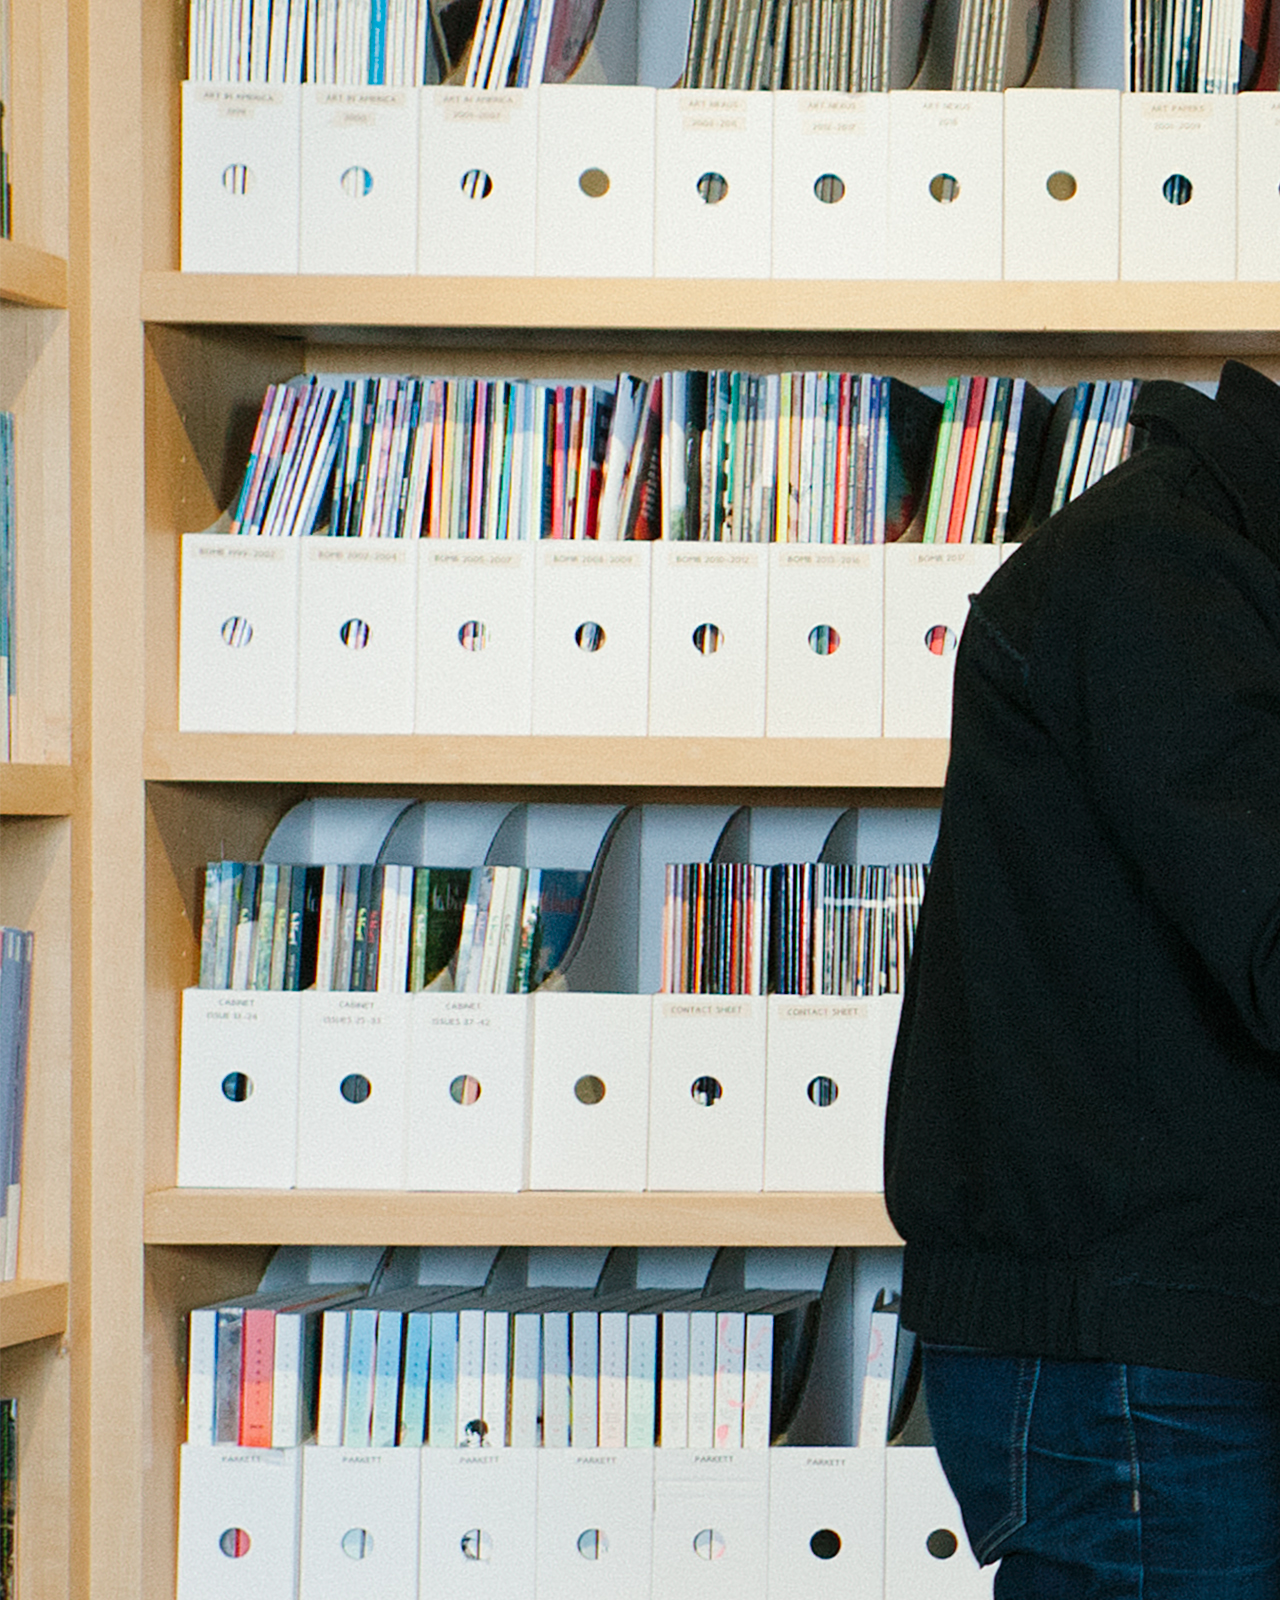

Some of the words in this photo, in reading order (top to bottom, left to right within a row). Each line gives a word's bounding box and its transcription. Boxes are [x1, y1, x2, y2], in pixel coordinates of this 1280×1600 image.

[670, 1006, 712, 1015] CONTACT
[716, 1006, 743, 1015] SHEET
[787, 1008, 829, 1017] CONTACT
[832, 1008, 859, 1017] SHEET
